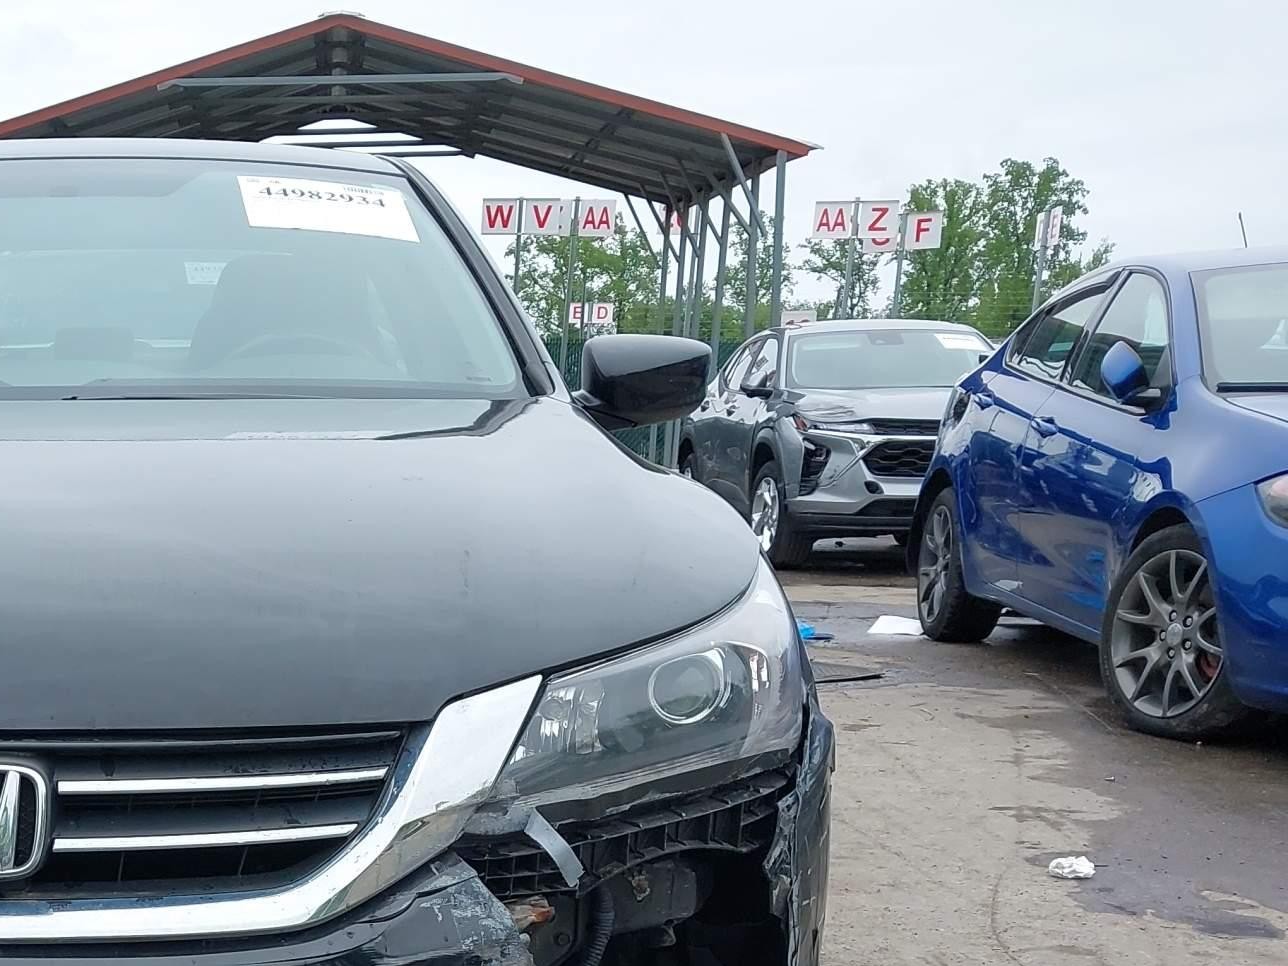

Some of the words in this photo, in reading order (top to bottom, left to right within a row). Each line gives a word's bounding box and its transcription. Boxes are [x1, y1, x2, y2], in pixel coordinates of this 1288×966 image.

[259, 186, 386, 208] 44982934
[486, 205, 513, 228] W
[533, 205, 552, 228] V
[582, 206, 610, 230] AA
[816, 207, 846, 232] AA
[868, 207, 889, 232] Z
[915, 218, 933, 243] F
[597, 306, 609, 320] D
